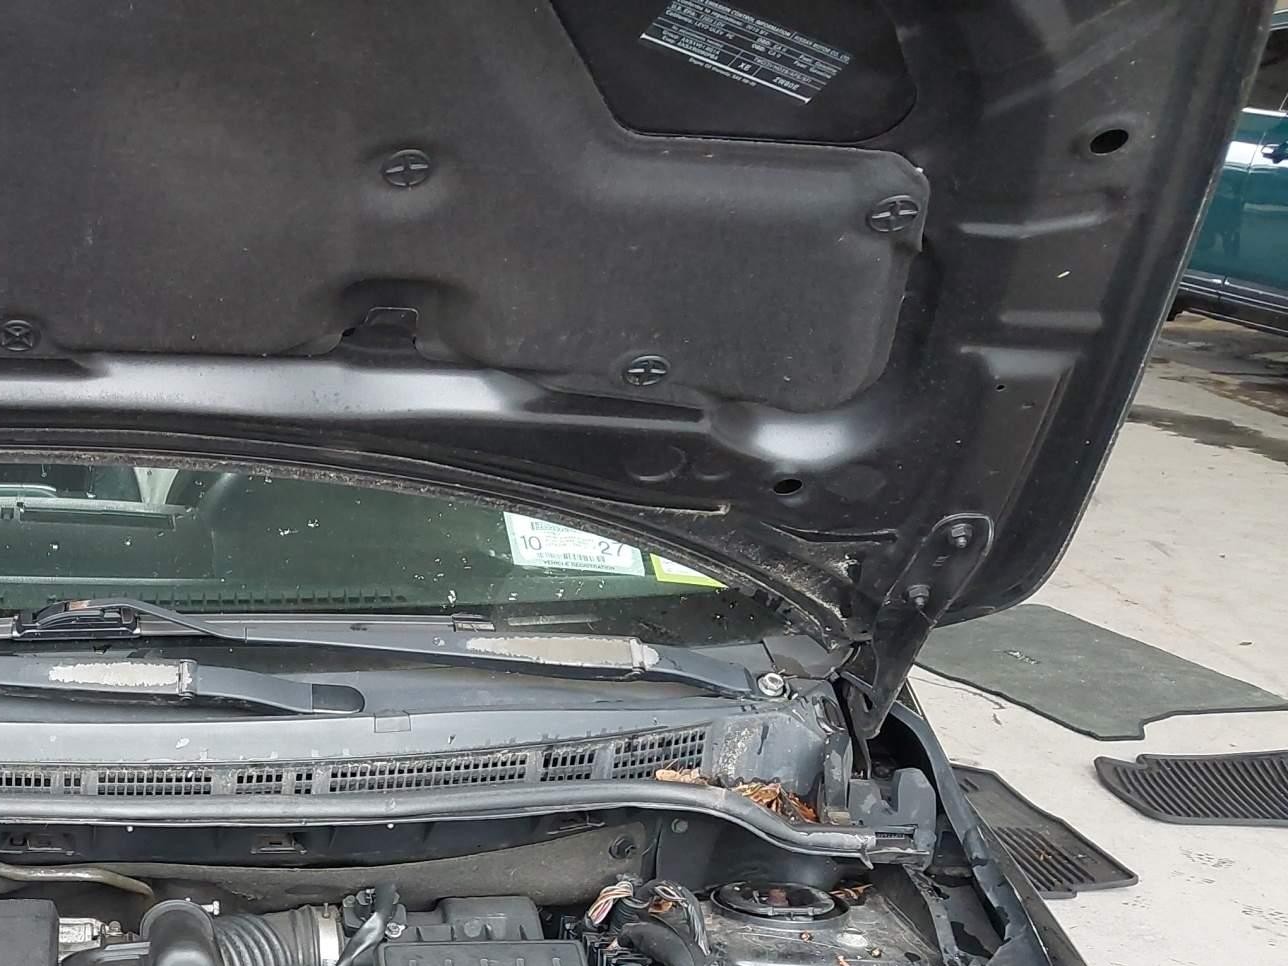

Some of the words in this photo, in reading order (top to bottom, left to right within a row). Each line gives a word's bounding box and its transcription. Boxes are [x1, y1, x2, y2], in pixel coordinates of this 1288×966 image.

[730, 9, 755, 23] CONTROL
[755, 19, 792, 36] INFORMATION
[519, 535, 542, 551] 10
[598, 540, 625, 557] 27
[543, 559, 574, 569] VEHICLE
